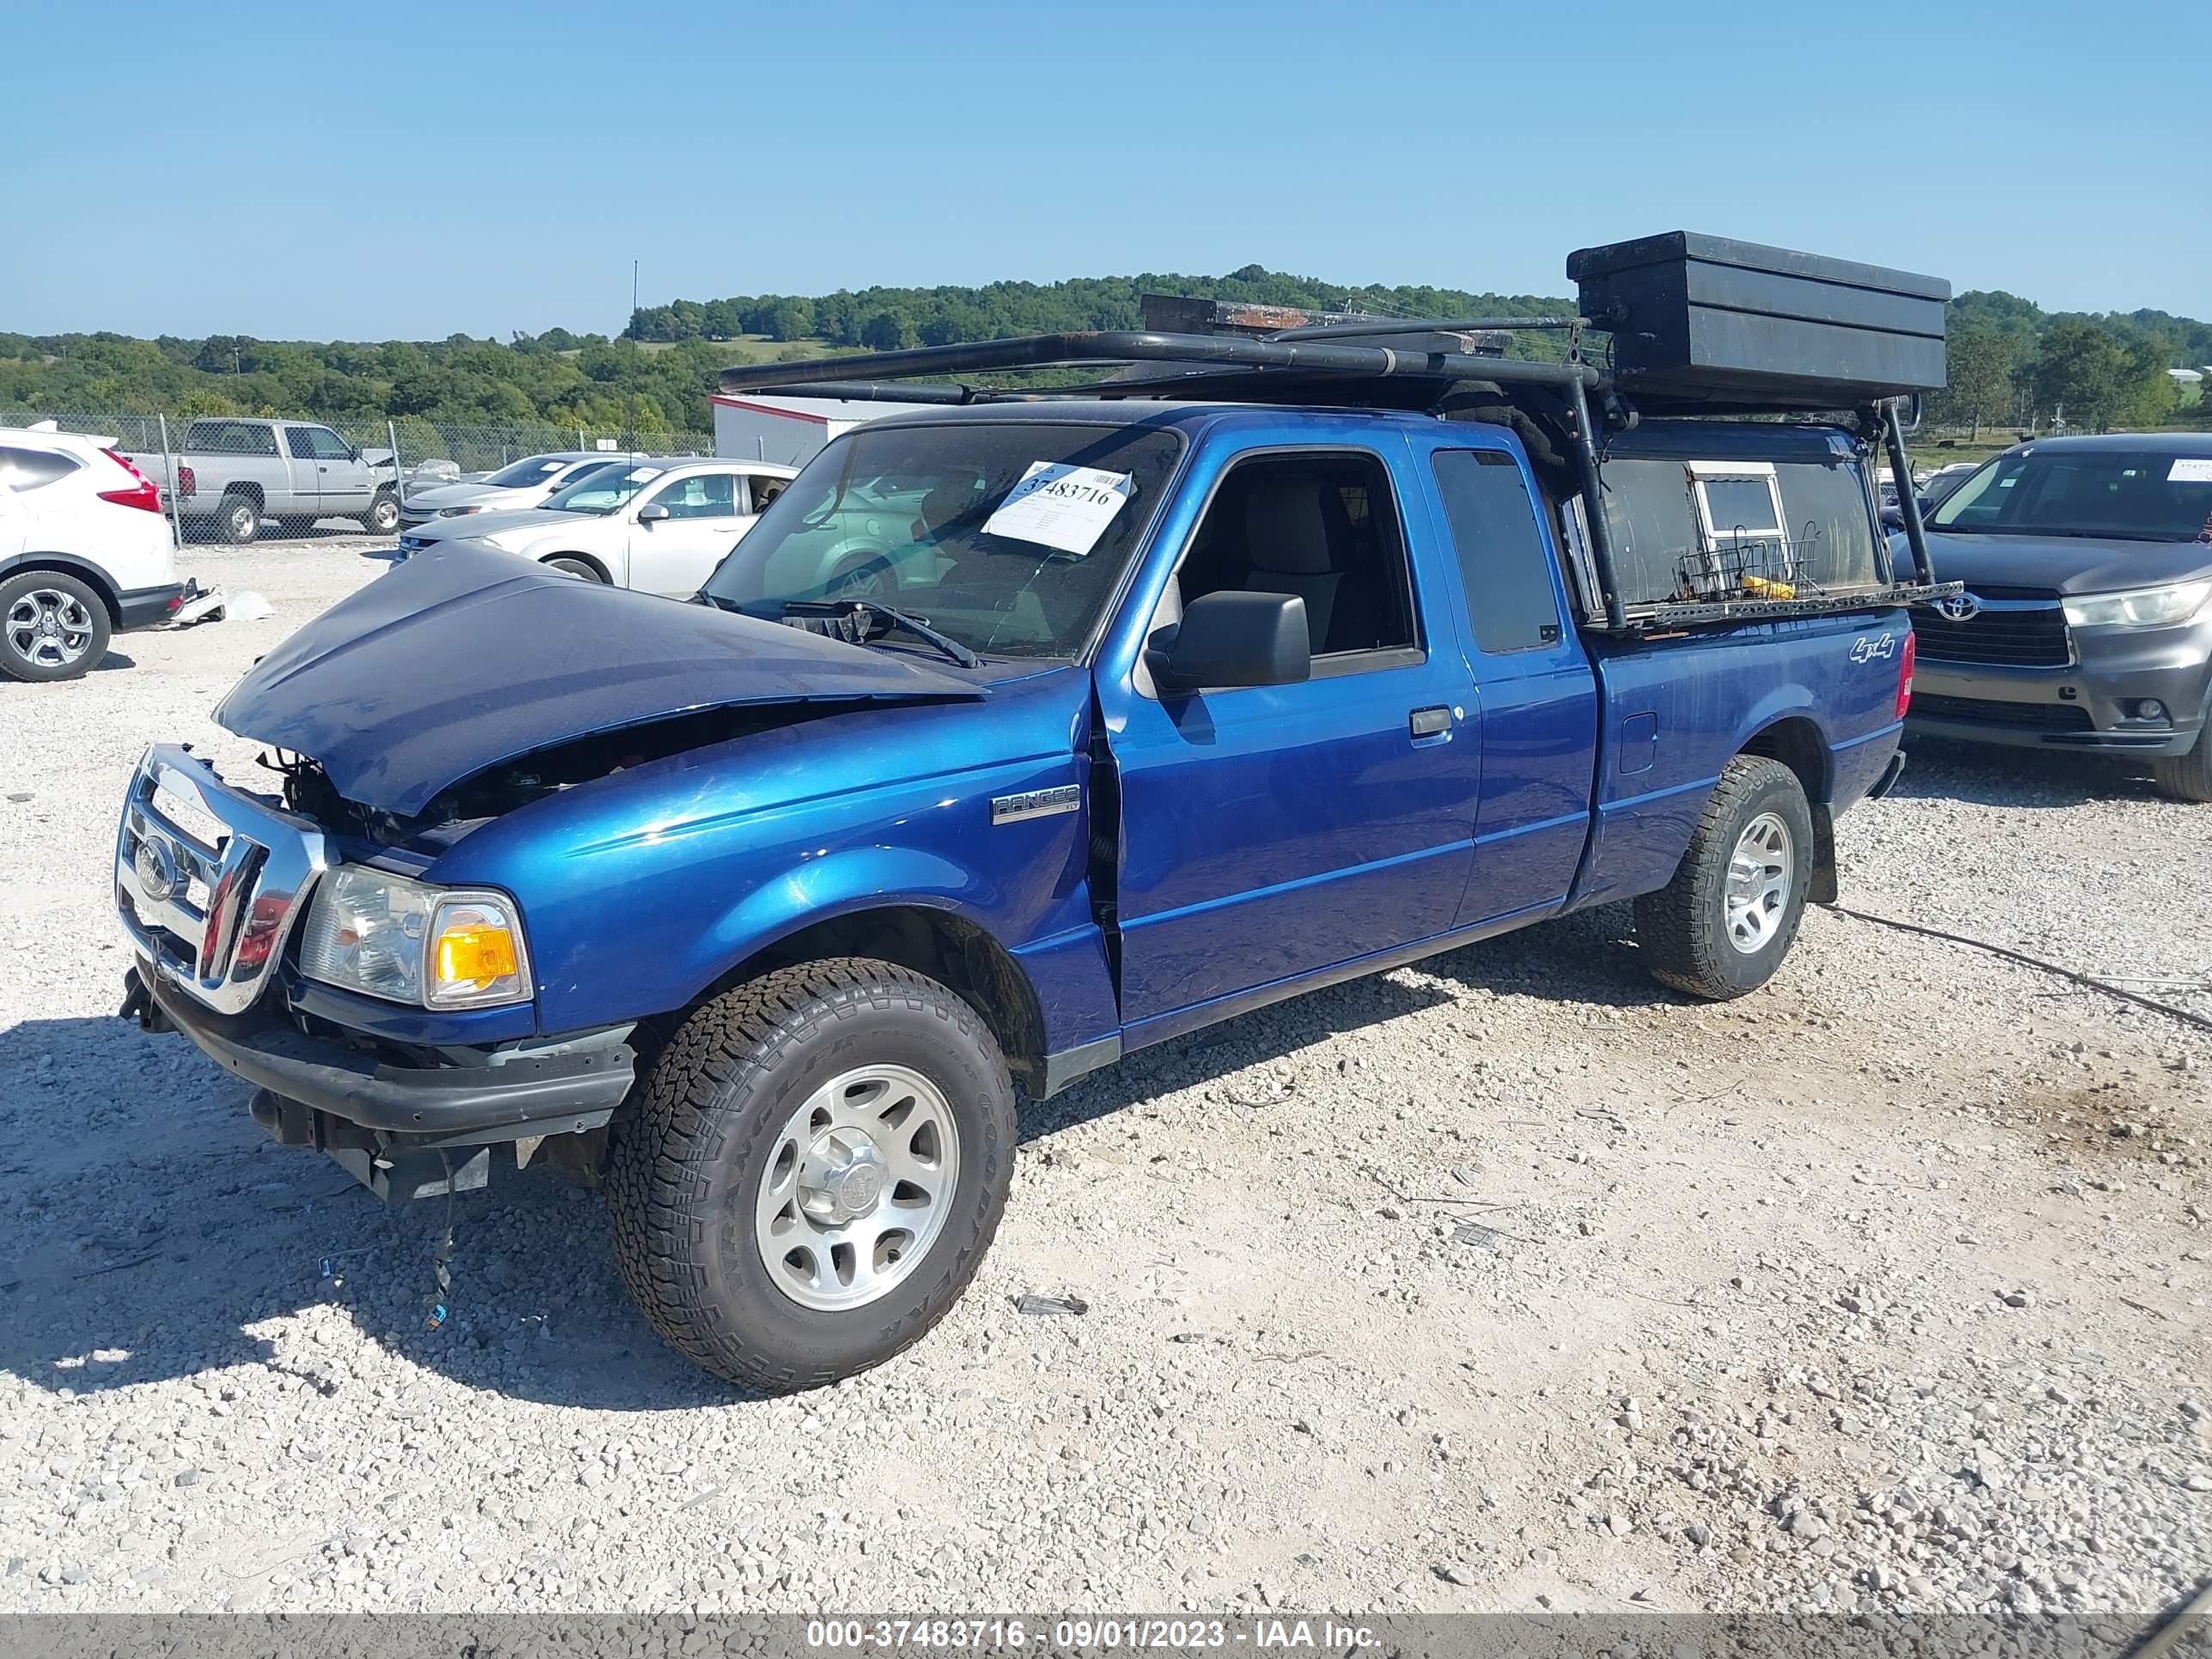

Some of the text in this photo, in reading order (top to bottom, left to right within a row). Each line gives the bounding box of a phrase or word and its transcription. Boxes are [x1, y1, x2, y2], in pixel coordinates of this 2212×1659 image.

[1023, 477, 1115, 506] 37483716
[1849, 632, 1895, 664] 4x4
[994, 787, 1080, 816] RANGER
[877, 1091, 999, 1346] GOODYEAR
